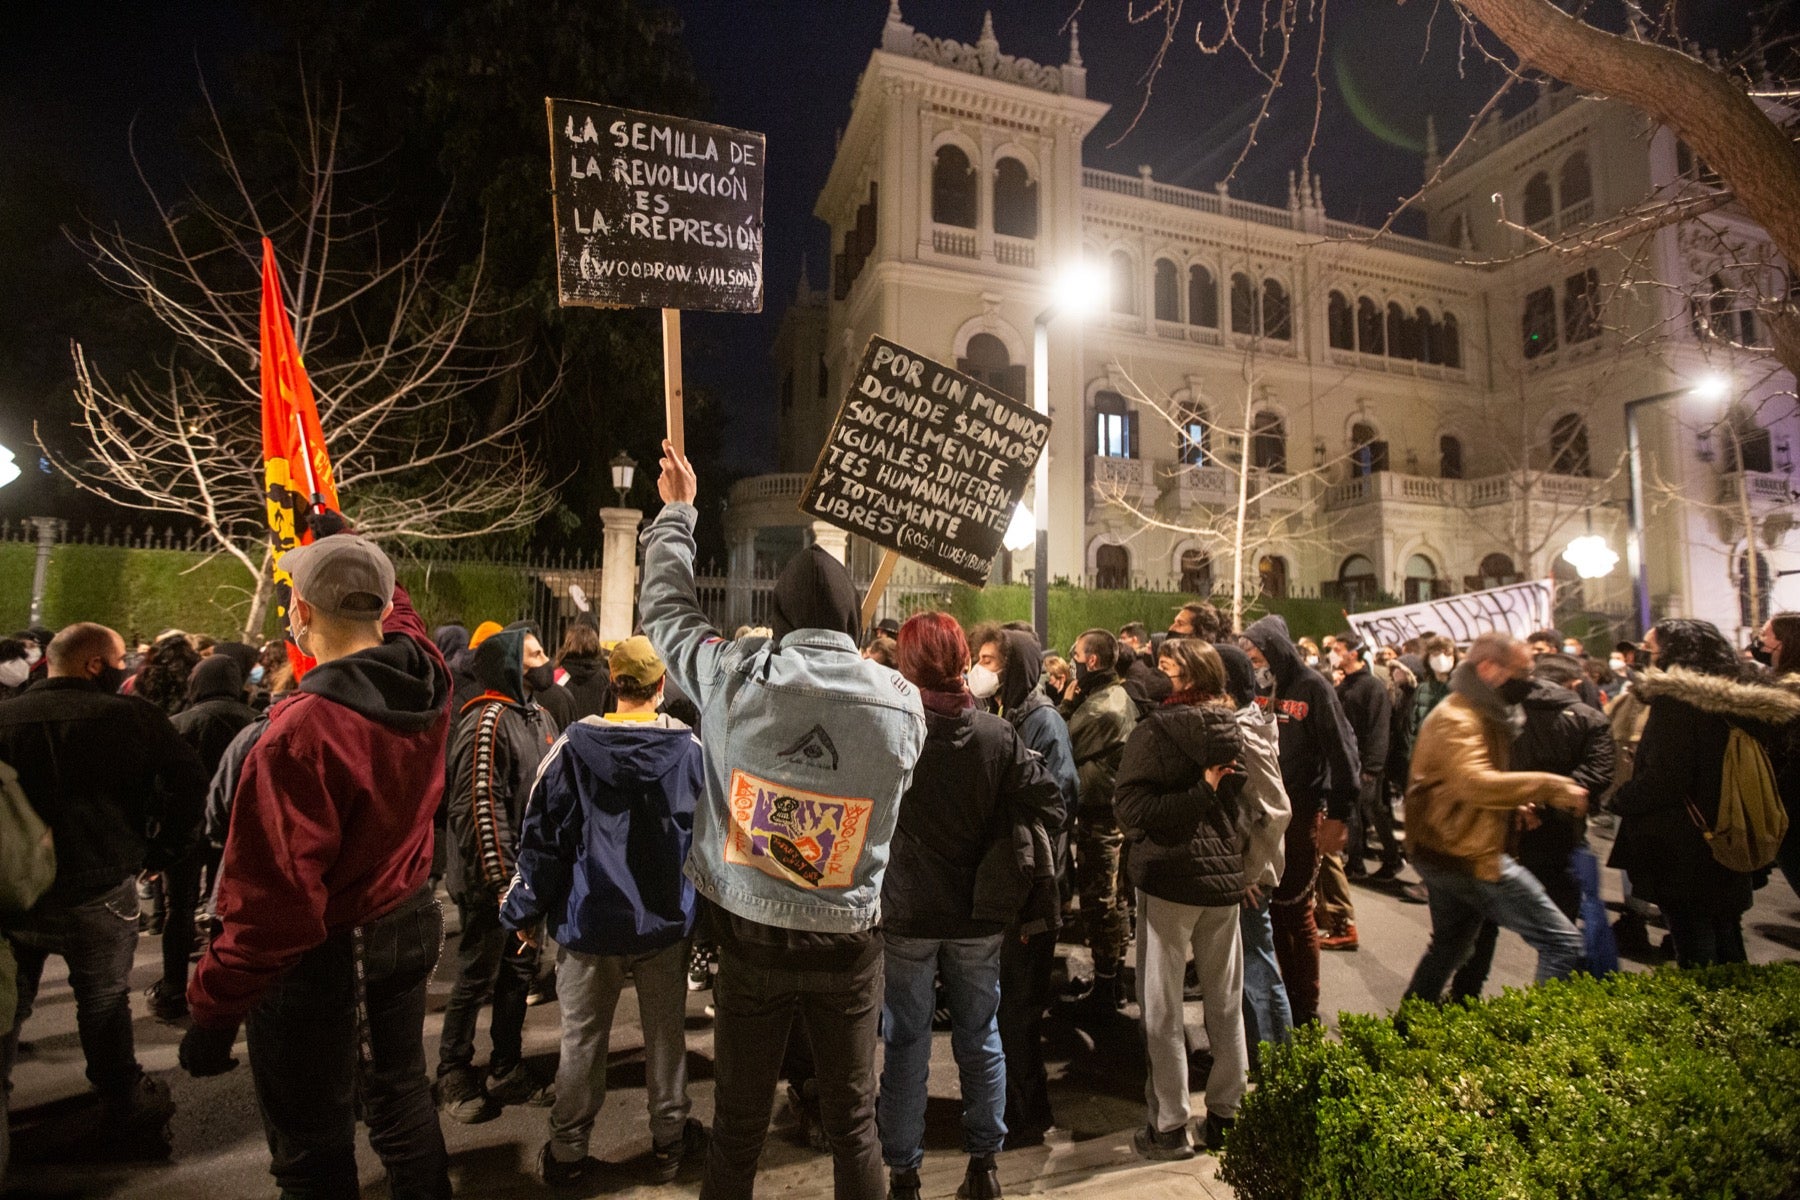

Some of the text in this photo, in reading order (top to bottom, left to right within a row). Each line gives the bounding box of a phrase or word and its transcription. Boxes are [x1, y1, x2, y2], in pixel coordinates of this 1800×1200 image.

[565, 115, 757, 166] LA SEMILLA DE
[571, 155, 747, 201] LA REVOLUCIÓN
[635, 191, 670, 214] ES
[574, 208, 761, 252] LA REPRESIÓN
[580, 248, 762, 298] (WOODROW WILSON)
[859, 374, 1039, 467] DONDE SEAMOS
[872, 346, 1048, 447] POR UN MUNDO
[845, 400, 1009, 482] SOCIALMENTE
[819, 468, 962, 539] Y TOTALMENTE
[829, 445, 1010, 533] TES HUMANAMENTE
[814, 492, 897, 535] LIBRES
[897, 523, 935, 552] (ROSA
